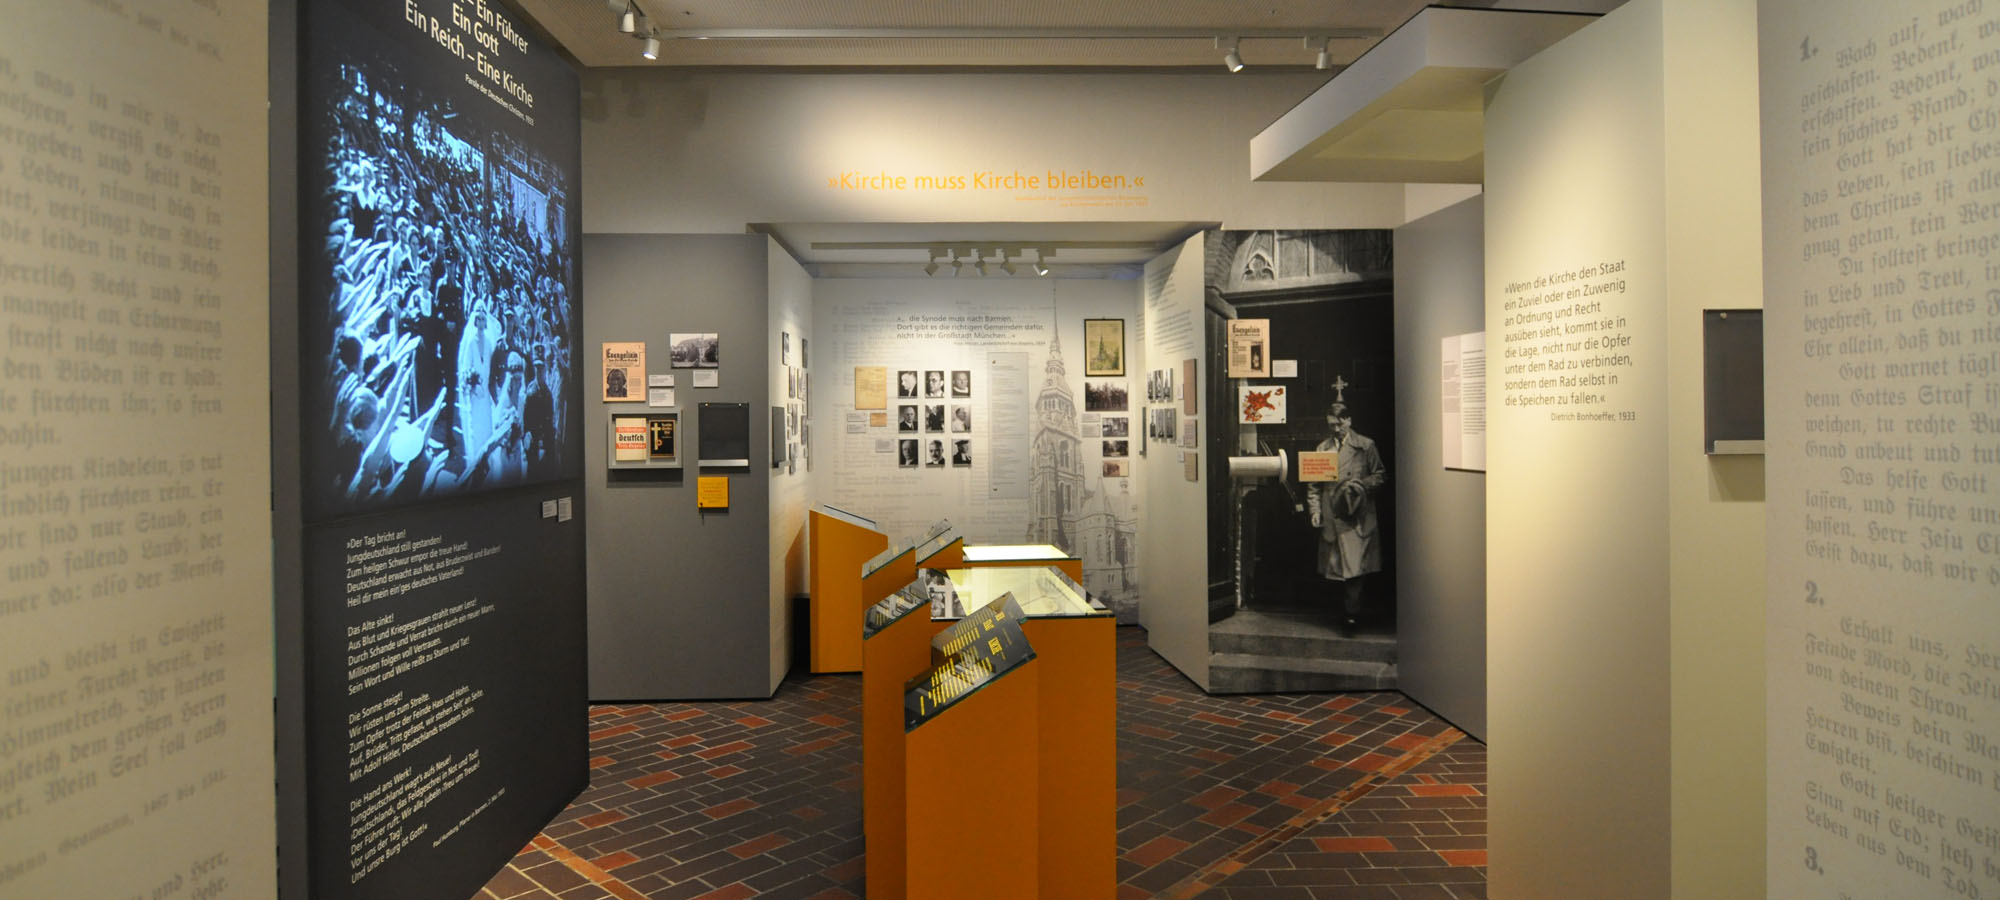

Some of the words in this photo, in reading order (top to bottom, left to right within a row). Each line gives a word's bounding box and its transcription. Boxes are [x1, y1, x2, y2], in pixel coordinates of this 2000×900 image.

[453, 2, 471, 34] Ein
[474, 22, 499, 57] Gott
[496, 13, 528, 54] Führer
[406, 0, 426, 32] Ein
[431, 17, 464, 59] Reich
[477, 51, 500, 85] Eine
[503, 71, 533, 108] Kirche
[1800, 34, 1819, 62] 1.
[827, 171, 906, 190] »Kirche
[915, 175, 966, 189] muss
[974, 171, 1039, 189] Kirche
[1048, 171, 1144, 189] bleiben.«
[1505, 283, 1531, 294] »Wenn
[1534, 276, 1546, 288] die
[1550, 270, 1576, 285] Kirche
[1579, 267, 1596, 279] den
[1600, 260, 1625, 276] Staat
[1505, 300, 1516, 310] ein
[1518, 294, 1542, 308] Zuviel
[1545, 291, 1565, 303] oder
[1567, 288, 1580, 299] ein
[1584, 279, 1625, 296] Zuwenig
[922, 315, 946, 323] Synode
[1505, 316, 1514, 326] an
[1516, 311, 1552, 325] Ordnung
[1555, 305, 1572, 318] und
[1575, 301, 1600, 314] Recht
[1886, 304, 1902, 323] in
[1912, 296, 1976, 320] Gottes
[1505, 329, 1537, 342] ausüben
[1540, 326, 1561, 337] sieht,
[1565, 320, 1597, 334] kommt
[1600, 317, 1613, 329] sie
[1616, 316, 1626, 328] in
[1505, 347, 1516, 358] die
[1519, 347, 1539, 359] Lage,
[1543, 343, 1563, 354] nicht
[1566, 341, 1581, 351] nur
[1585, 337, 1599, 350] die
[1602, 334, 1631, 350] Opfer
[1505, 364, 1525, 374] unter
[1528, 362, 1545, 372] dem
[1549, 360, 1564, 370] Rad
[1568, 360, 1578, 368] zu
[1581, 353, 1632, 368] verbinden,
[1839, 362, 1876, 381] Gott
[1885, 357, 1948, 377] warnet
[1505, 379, 1536, 390] sondern
[1539, 377, 1557, 388] dem
[1560, 375, 1576, 387] Rad
[1579, 373, 1605, 386] selbst
[1609, 372, 1617, 384] in
[1505, 395, 1516, 405] die
[1520, 394, 1555, 408] Speichen
[1558, 395, 1568, 404] zu
[1571, 392, 1605, 404] fallen.«
[1551, 412, 1575, 421] Dietrich
[1577, 412, 1616, 421] Bonhoeffer,
[1619, 411, 1636, 421] 1933
[1906, 414, 1956, 438] rechte
[1942, 471, 1987, 493] Gott
[347, 538, 362, 548] »Der
[364, 536, 376, 547] Tag
[377, 532, 395, 543] bricht
[396, 529, 406, 539] an!
[347, 544, 399, 564] Jungdeutschland
[401, 541, 411, 551] still
[413, 535, 442, 551] gestanden!
[347, 566, 362, 578] Zum
[389, 557, 409, 569] Schwur
[411, 552, 428, 562] empor
[430, 549, 438, 557] die
[347, 595, 360, 607] Heil
[362, 592, 371, 603] dir
[373, 589, 389, 600] mein
[412, 575, 438, 588] deutsches
[439, 566, 464, 580] Vaterland!
[1805, 581, 1824, 606] 2.
[348, 626, 360, 637] Das
[362, 620, 375, 632] Alte
[377, 613, 394, 627] sinkt!
[349, 662, 380, 680] Millionen
[381, 653, 401, 667] folgen
[402, 647, 413, 658] voll
[349, 683, 363, 695] Sein
[364, 675, 381, 688] Wort
[382, 667, 394, 681] und
[396, 662, 410, 675] Wille
[1841, 666, 1899, 701] deinem
[349, 712, 360, 724] Die
[362, 703, 382, 718] Sonne
[384, 691, 402, 707] steigt!
[351, 799, 362, 812] Die
[363, 785, 380, 803] Hand
[382, 781, 392, 792] ans
[394, 766, 412, 784] Werk!
[1840, 770, 1876, 799] Gott
[351, 842, 363, 855] Der
[365, 826, 386, 845] Führer
[351, 856, 363, 869] Vor
[365, 846, 376, 860] uns
[378, 838, 388, 851] der
[389, 826, 402, 842] Tag!
[352, 866, 365, 884] Und
[367, 855, 384, 872] unsre
[386, 843, 400, 859] Burg
[1805, 846, 1824, 875] 3.
